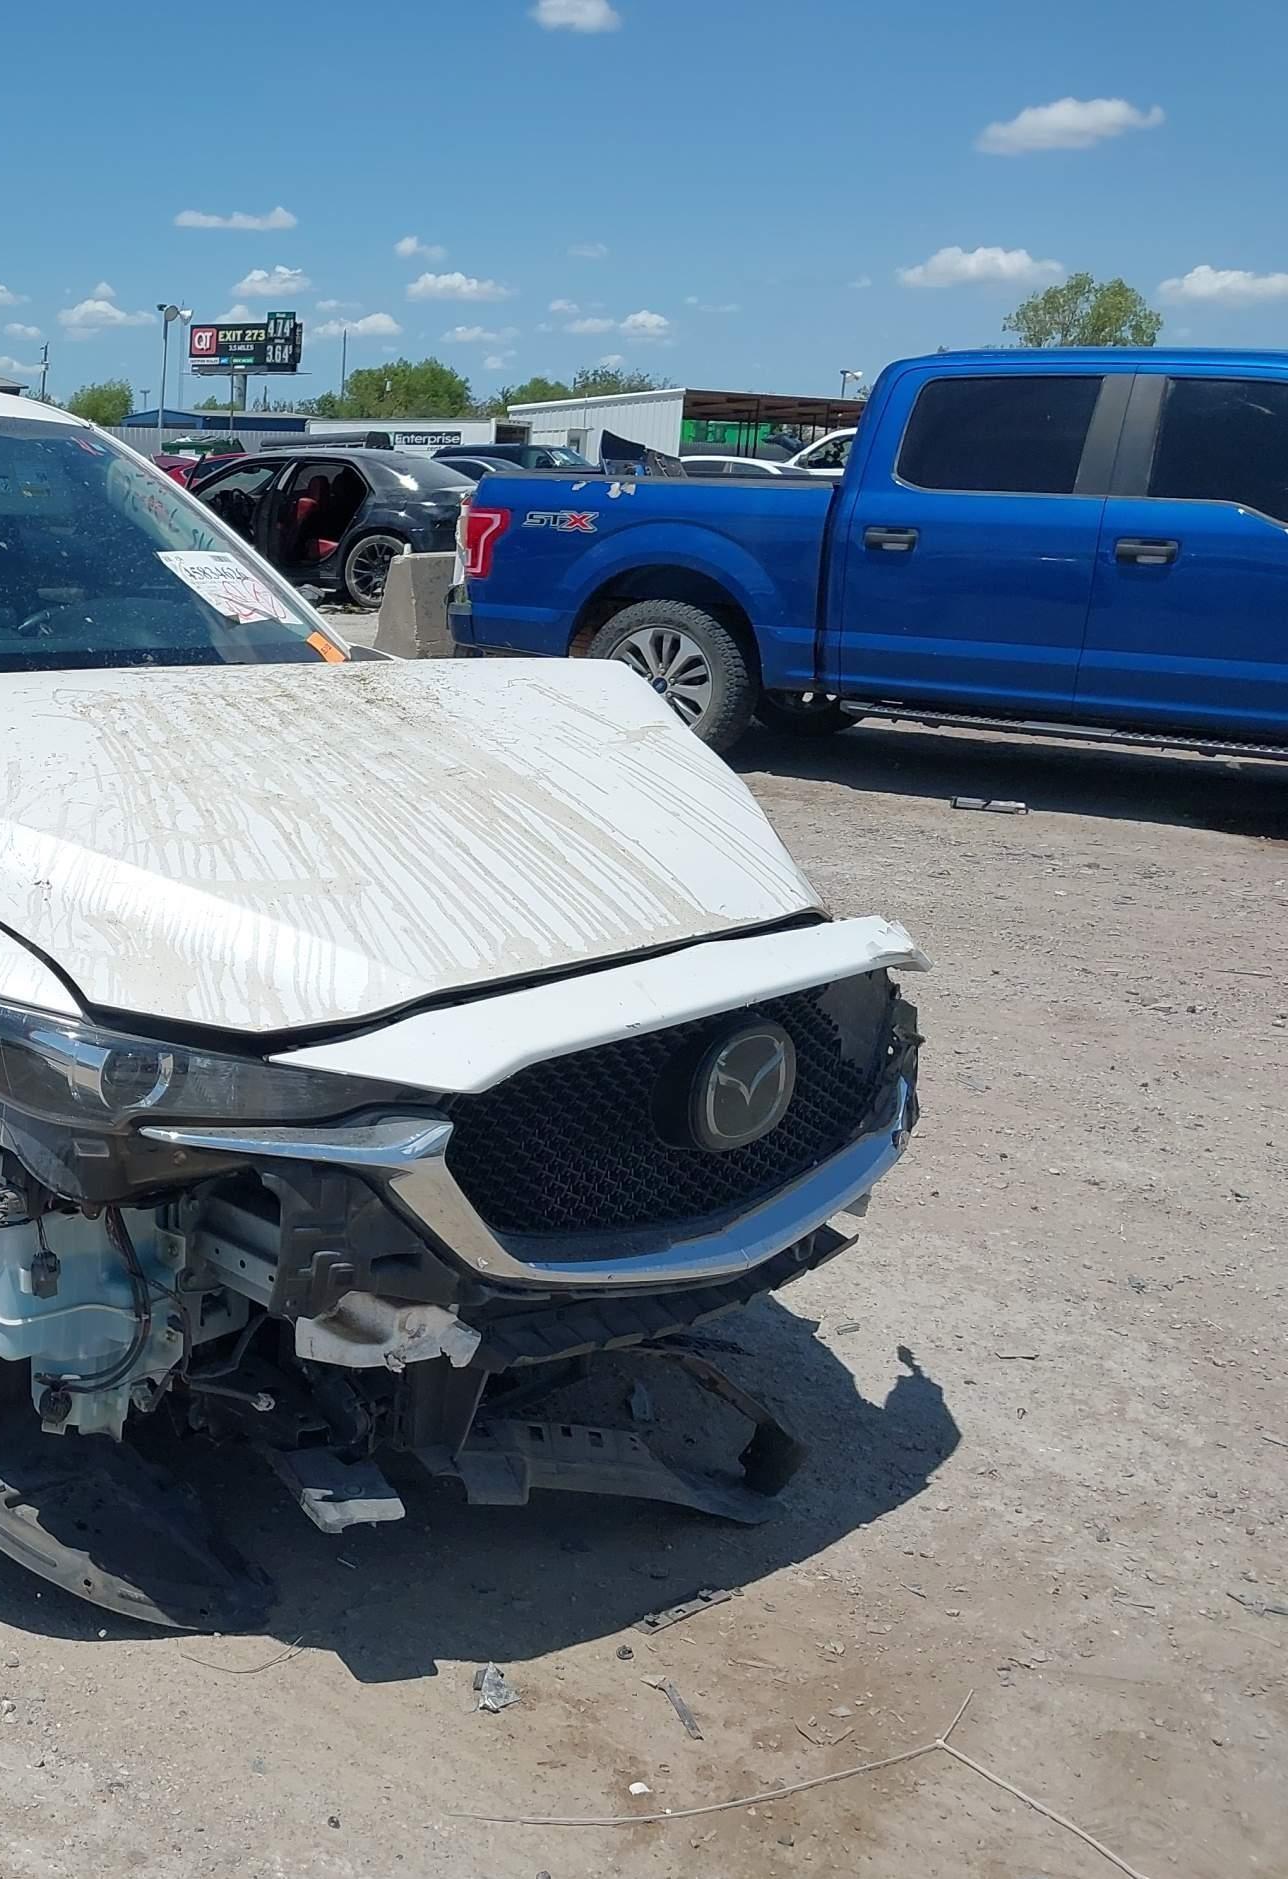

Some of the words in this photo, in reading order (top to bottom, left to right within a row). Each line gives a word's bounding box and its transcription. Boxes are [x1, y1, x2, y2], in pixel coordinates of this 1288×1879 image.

[195, 332, 212, 350] QT
[218, 330, 243, 341] EXIT
[245, 330, 265, 340] 273
[395, 433, 460, 445] Enterprise
[521, 510, 599, 533] STX
